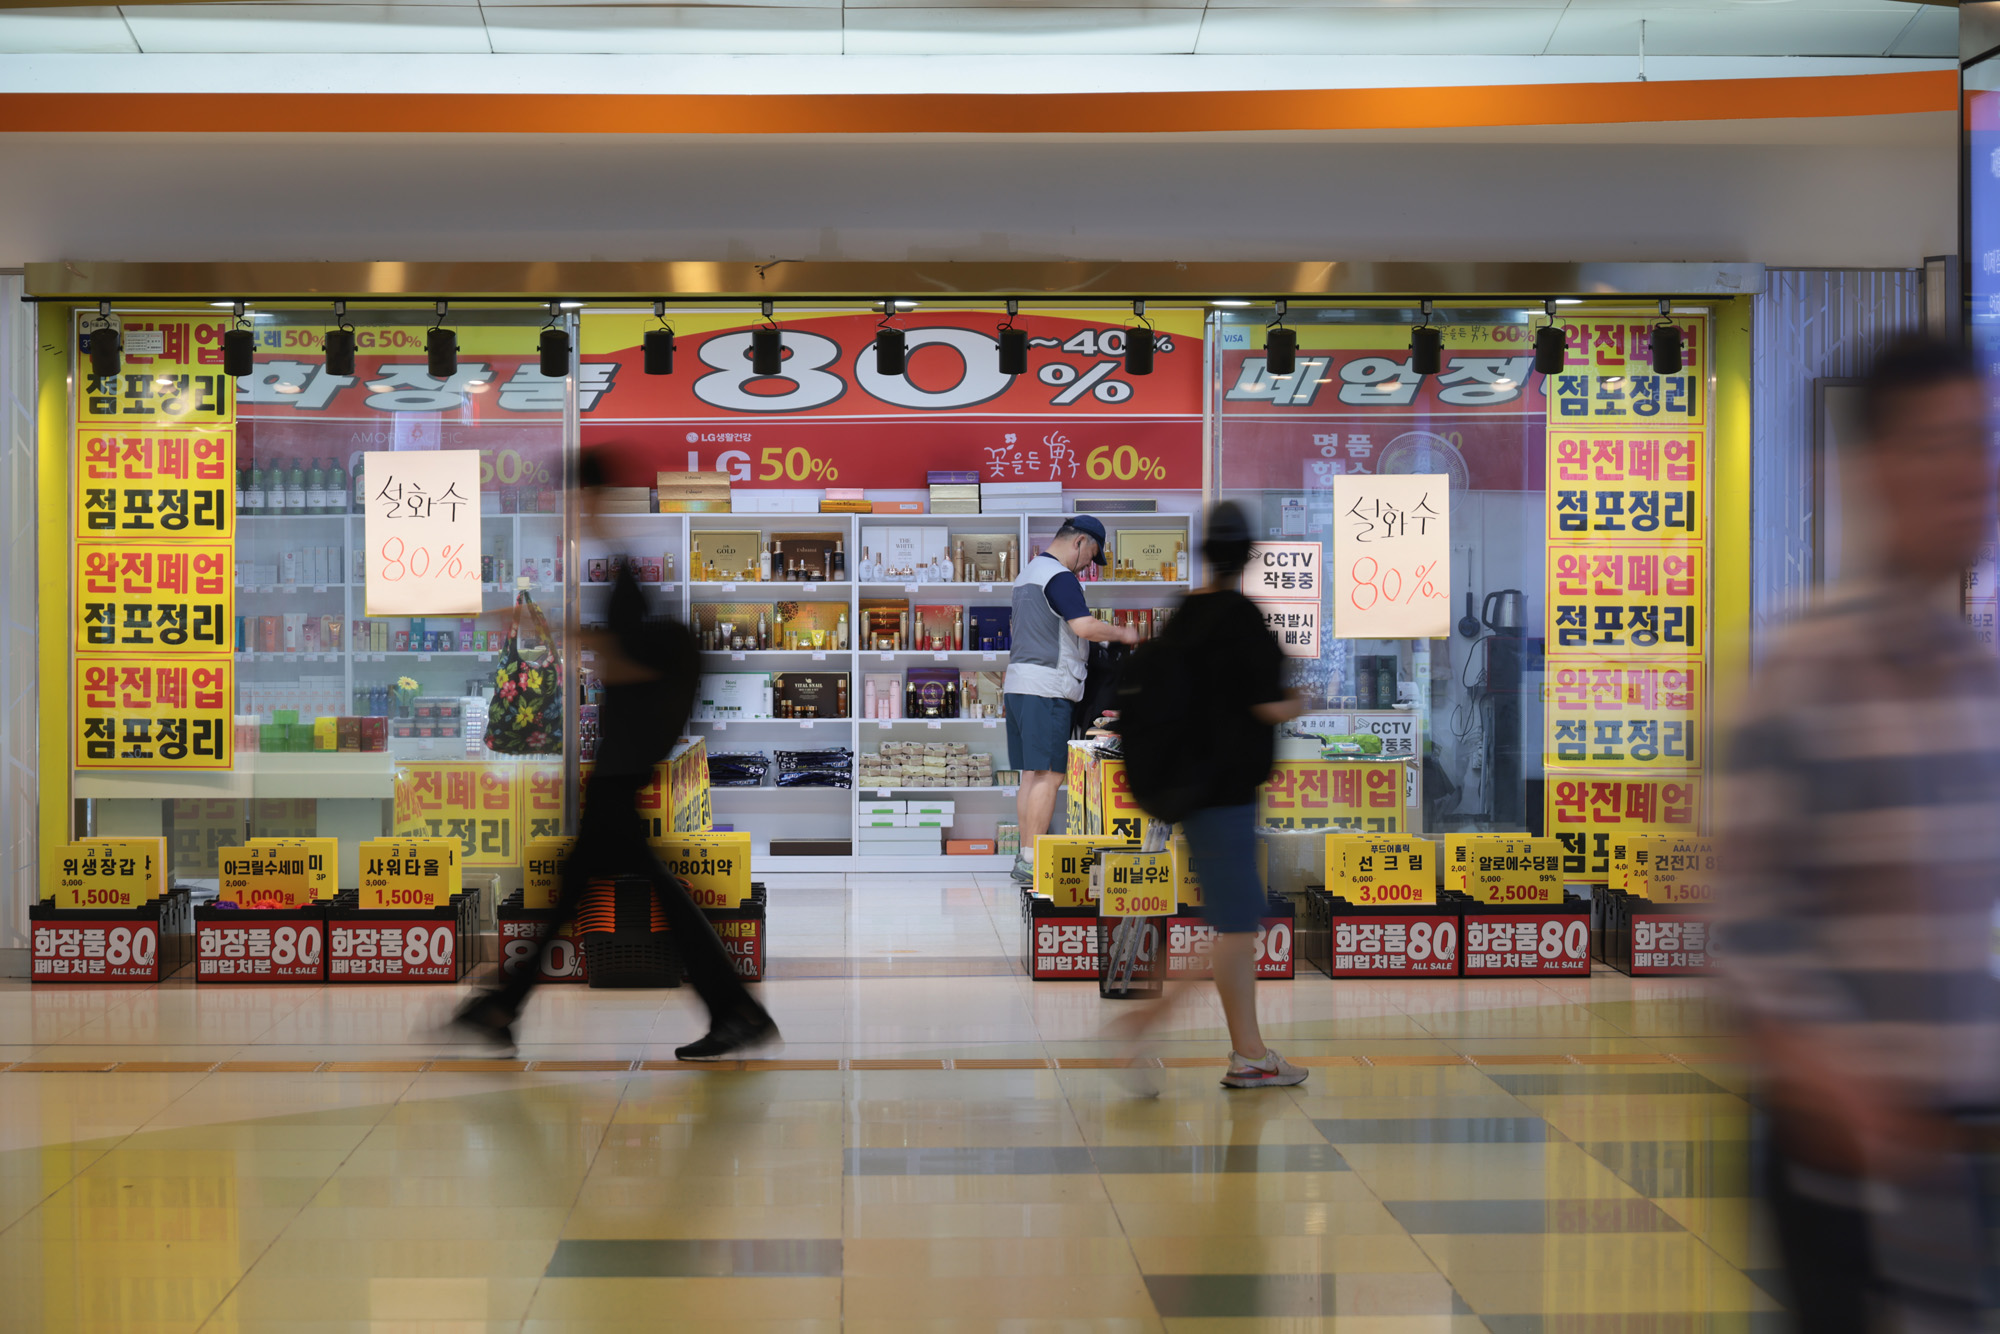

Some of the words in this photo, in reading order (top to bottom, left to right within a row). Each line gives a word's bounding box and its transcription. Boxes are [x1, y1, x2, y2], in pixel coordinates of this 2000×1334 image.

[285, 330, 326, 347] 50%
[378, 330, 421, 347] 50%
[1224, 334, 1244, 342] VISA
[1491, 325, 1535, 342] 60%
[236, 360, 622, 413] 화장품
[1225, 355, 1546, 407] 폐업정
[86, 374, 224, 415] 점포정리
[1557, 375, 1696, 416] 점포정리
[701, 433, 752, 442] LG생활건강
[1312, 433, 1374, 458] 명품
[85, 438, 224, 480] 완전폐업
[687, 450, 752, 481] LG
[759, 446, 839, 481] 50%
[1086, 445, 1166, 481] 60%
[1556, 440, 1695, 481] 완전폐업
[376, 475, 469, 522] 설화수
[84, 489, 225, 530] 점포정리
[1344, 492, 1441, 543] 설화수
[1556, 490, 1695, 531] 점포정리
[1263, 551, 1313, 567] CCTV
[84, 552, 223, 595] 완전폐업
[1263, 572, 1313, 589] 작동중
[1556, 554, 1695, 596] 완전폐업
[84, 602, 224, 645] 점포정리
[1261, 613, 1313, 628] 난적발시
[1555, 605, 1695, 647] 점포정리
[1286, 631, 1313, 645] 배상
[84, 667, 223, 709] 완전폐업
[1555, 668, 1694, 711] 완전폐업
[1371, 722, 1412, 735] CCTV
[83, 717, 223, 760] 점포정리
[1381, 738, 1412, 753] 동중
[1554, 719, 1695, 762] 점포정리
[1264, 768, 1397, 809] 완전폐업
[1554, 781, 1694, 824] 완전폐업
[87, 848, 113, 857] 고급
[251, 848, 277, 857] 고급
[391, 848, 417, 857] 고급
[682, 848, 708, 857] 애경
[1370, 844, 1410, 854] 푸드어홀릭
[1506, 844, 1532, 853] 고급
[1555, 832, 1610, 874] 점포
[1673, 845, 1690, 853] AAA
[63, 858, 136, 876] 위생장갑
[224, 860, 304, 875] 아크릴수세미
[367, 859, 439, 876] 샤워타올
[1133, 857, 1156, 865] 고급
[1358, 855, 1423, 872] 선크림
[1479, 856, 1559, 871] 알로에수딩젤
[1655, 855, 1700, 872] 건전지
[61, 879, 83, 887] 3,000
[365, 879, 387, 887] 3,000
[530, 879, 551, 887] 1,500
[1113, 866, 1170, 884] 비닐우산
[1481, 875, 1501, 883] 5,000
[1539, 874, 1557, 882] 99%
[1654, 874, 1675, 882] 3,500
[225, 880, 247, 888] 2,000
[1107, 887, 1128, 895] 6,000
[71, 889, 131, 907] 1,500원
[235, 889, 295, 907] 1,000원
[375, 889, 435, 907] 1,500원
[1359, 884, 1423, 904] 3,000원
[1489, 884, 1549, 903] 2,500원
[1663, 885, 1713, 902] 1,500
[1115, 896, 1168, 914] 3,000원
[1037, 923, 1109, 954] 화장품
[1169, 923, 1222, 954] 화장
[1335, 922, 1407, 953] 화장품
[1406, 922, 1457, 961] 80%
[1467, 921, 1539, 951] 화장품
[1538, 920, 1588, 959] 80%
[1634, 921, 1706, 951] 화장품
[34, 927, 106, 957] 화장품
[106, 926, 156, 966] 80%
[200, 927, 272, 957] 화장품
[271, 926, 321, 965] 80%
[331, 927, 404, 957] 화장품
[403, 926, 454, 966] 80%
[724, 941, 755, 955] ALE
[34, 959, 106, 974] 폐업처분
[200, 959, 272, 974] 폐업처분
[331, 959, 404, 974] 폐업처분
[1037, 956, 1109, 971] 폐업처분
[1264, 964, 1287, 972] SALE
[1335, 954, 1407, 969] 폐업처분
[1412, 962, 1428, 970] ALL
[1430, 962, 1452, 970] SALE
[1467, 953, 1539, 968] 폐업처분
[1543, 961, 1560, 969] ALL
[1561, 961, 1584, 969] SALE
[1634, 952, 1705, 968] 폐업처분
[277, 967, 294, 975] ALL
[295, 967, 318, 975] SALE
[409, 967, 425, 975] ALL
[427, 967, 449, 975] SALE
